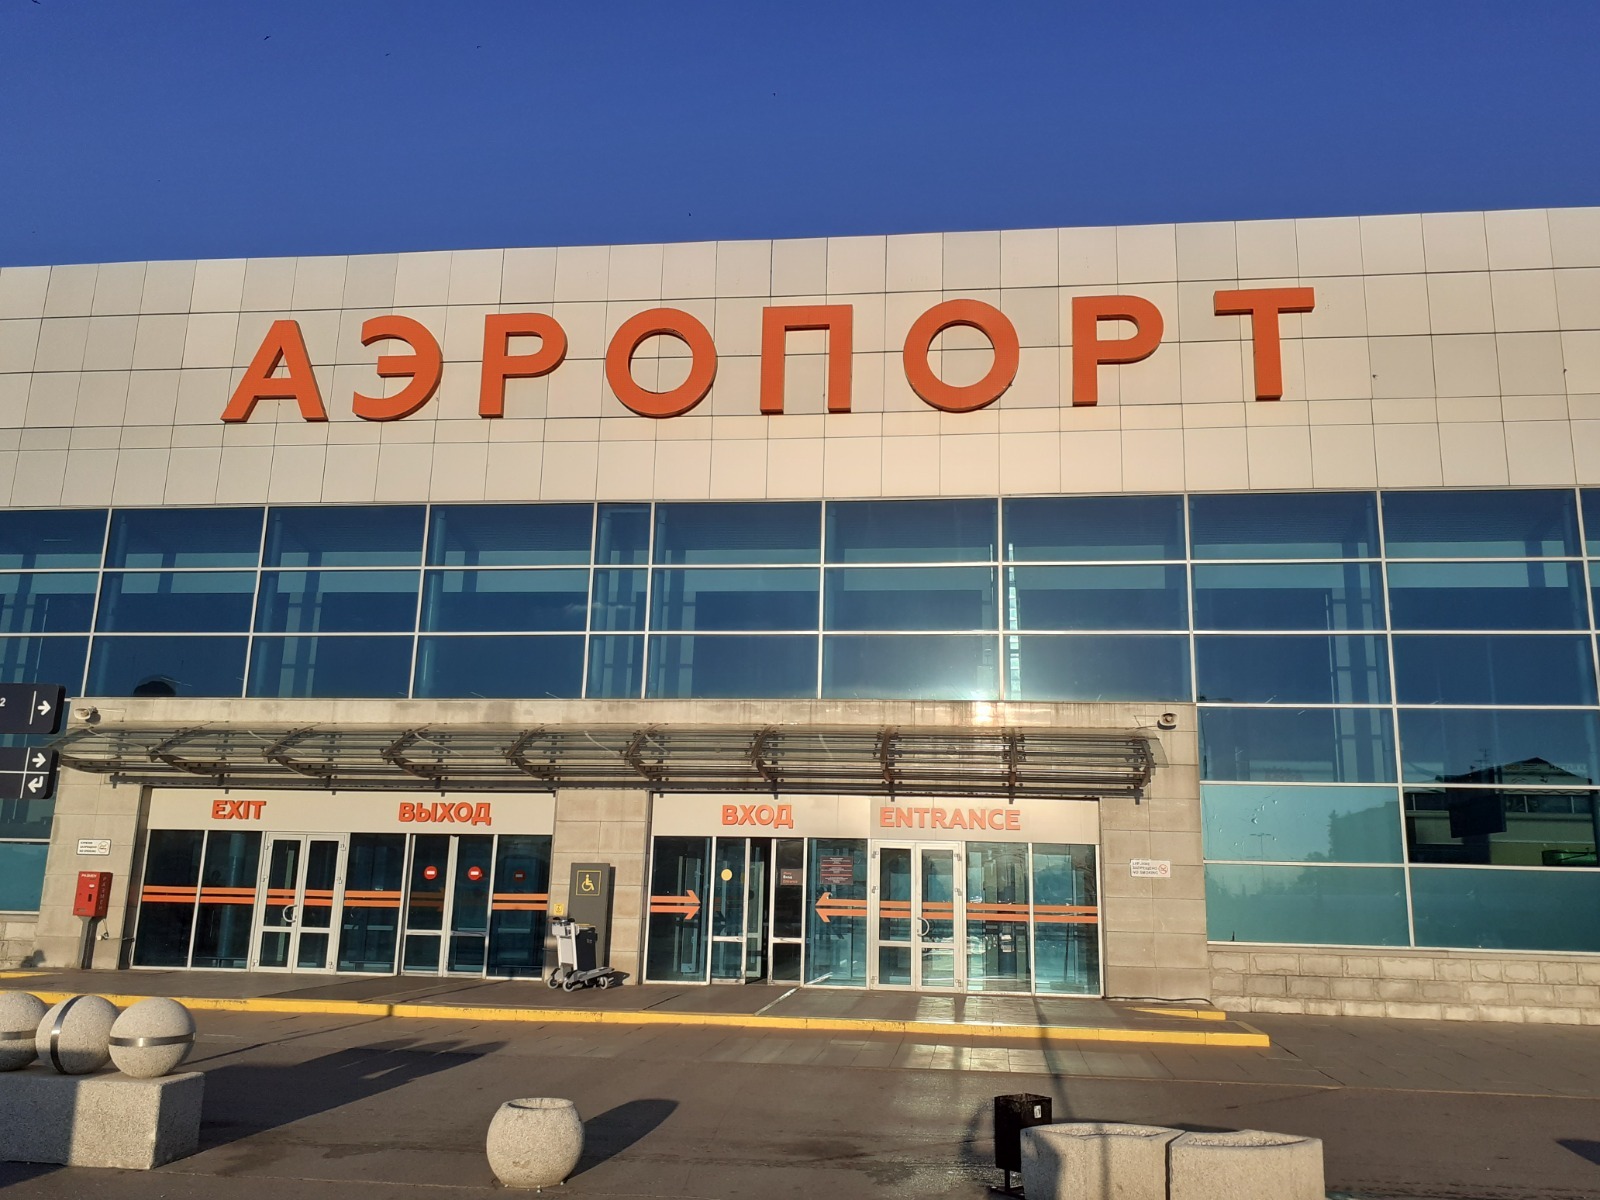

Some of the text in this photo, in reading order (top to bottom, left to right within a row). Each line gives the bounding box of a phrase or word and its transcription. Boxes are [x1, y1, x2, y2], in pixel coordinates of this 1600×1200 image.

[220, 287, 1315, 422] АЭРОПОРТ
[211, 799, 267, 820] EXIT
[398, 802, 492, 826] ВЫХОД
[721, 804, 794, 829] ВХОД
[879, 806, 1021, 830] ENTRANCE
